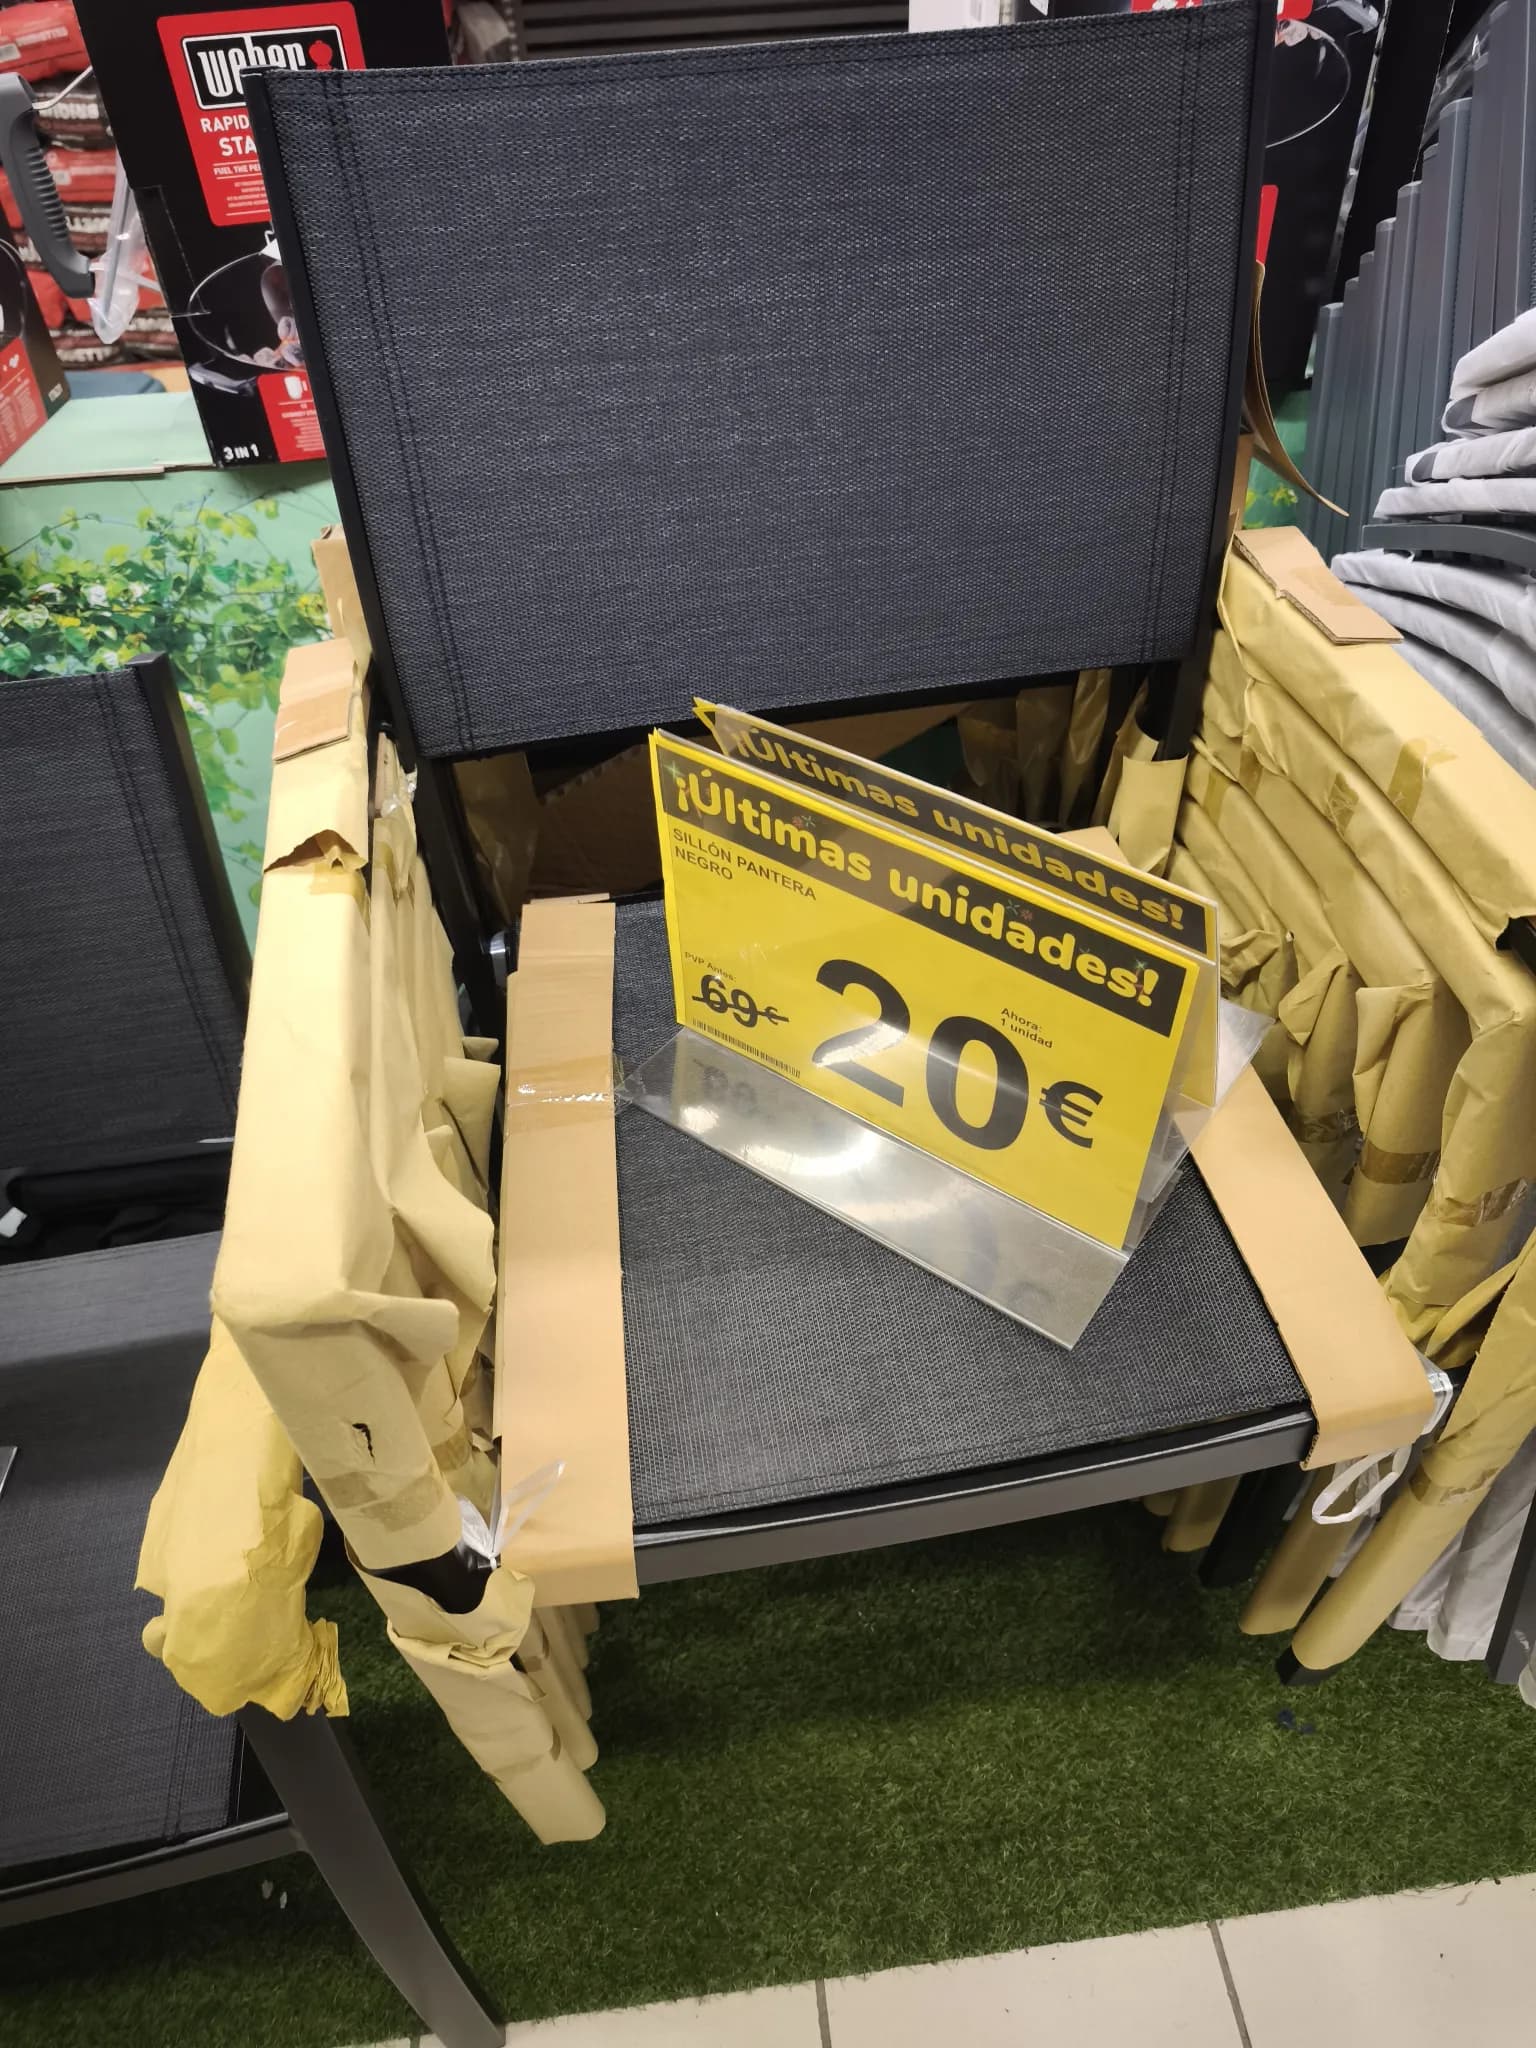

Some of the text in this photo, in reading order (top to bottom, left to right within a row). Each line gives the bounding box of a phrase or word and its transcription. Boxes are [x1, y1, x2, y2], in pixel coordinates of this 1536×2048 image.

[213, 166, 233, 176] FUEL
[234, 164, 248, 174] THE
[223, 443, 259, 460] 3 IN 1
[732, 728, 1184, 931] ¡Últimas unidades!
[673, 827, 817, 901] SILLÓN PANTERA
[675, 846, 733, 880] NEGRO
[676, 768, 1160, 1007] ¡Últimas unidades!
[684, 951, 737, 982] PVP Antes:
[1001, 1008, 1042, 1033] Ahora:
[1001, 1018, 1053, 1049] 1 unidad
